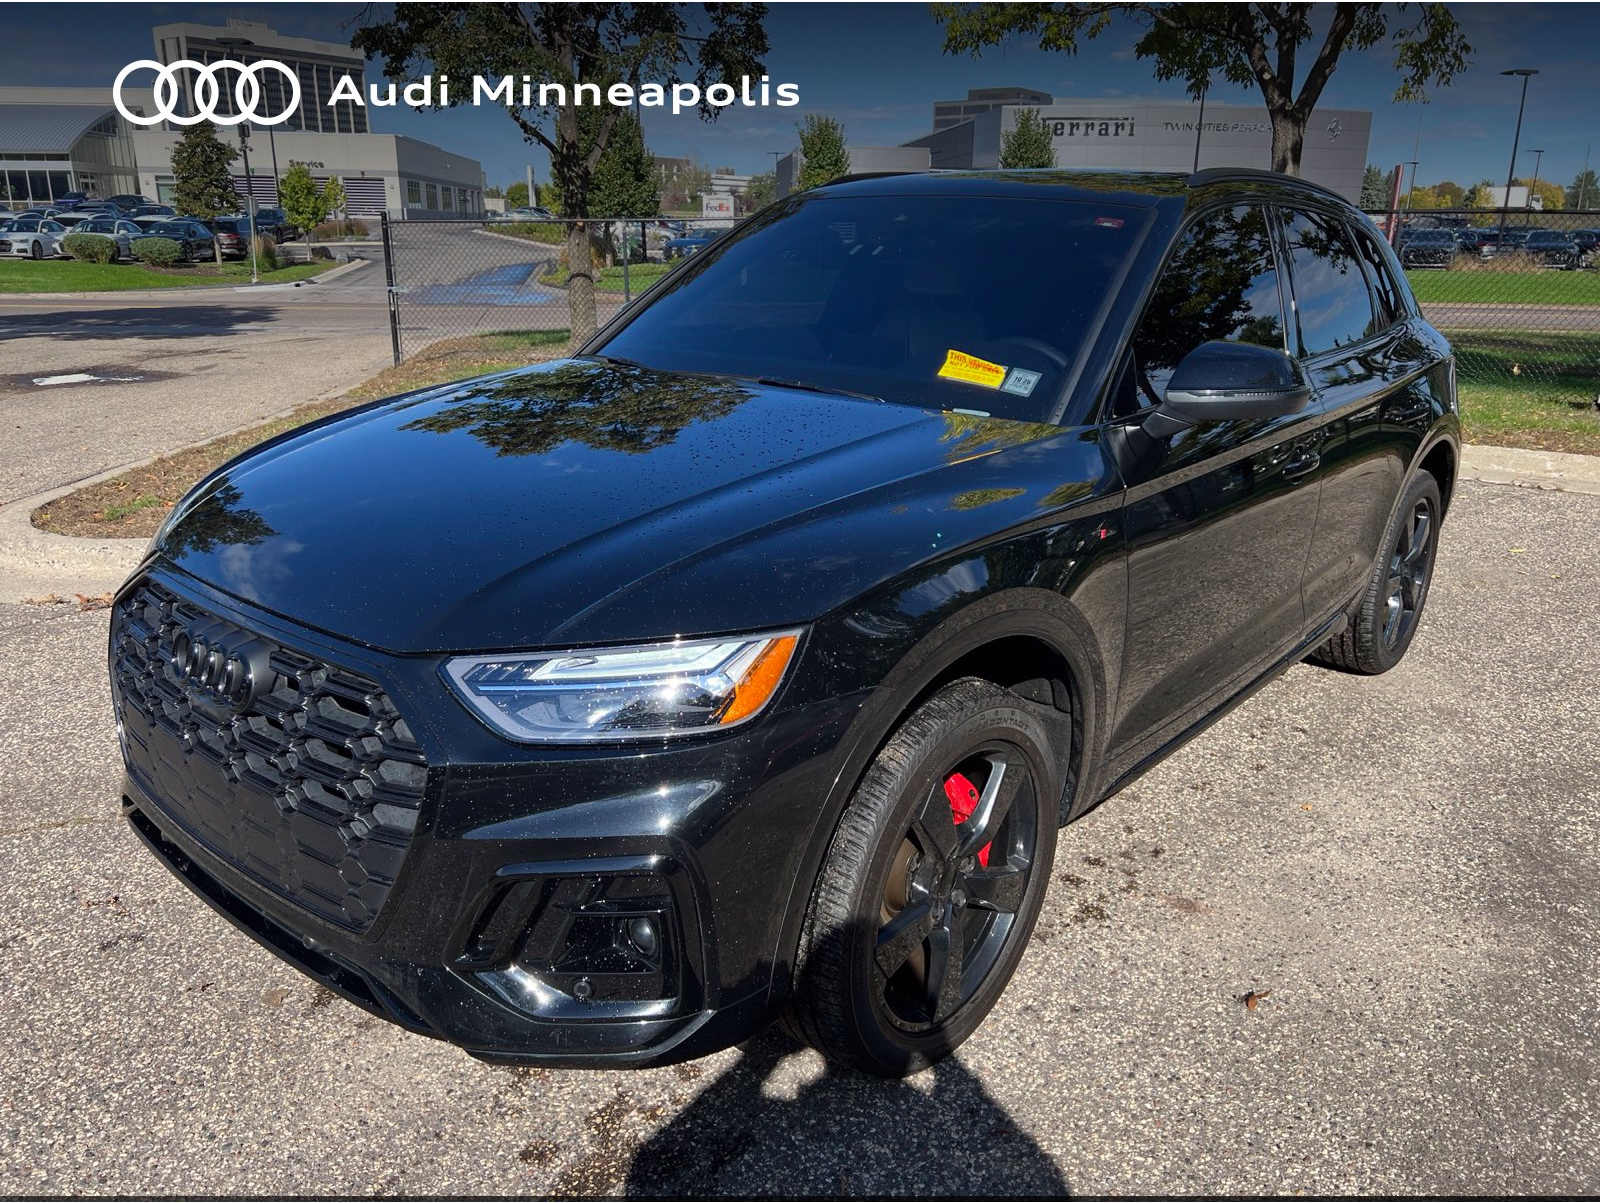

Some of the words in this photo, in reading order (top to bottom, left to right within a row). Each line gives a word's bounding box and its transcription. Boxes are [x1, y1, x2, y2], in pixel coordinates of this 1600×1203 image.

[1164, 121, 1193, 132] TWIN
[1195, 121, 1229, 133] CITIES
[288, 159, 325, 169] Service
